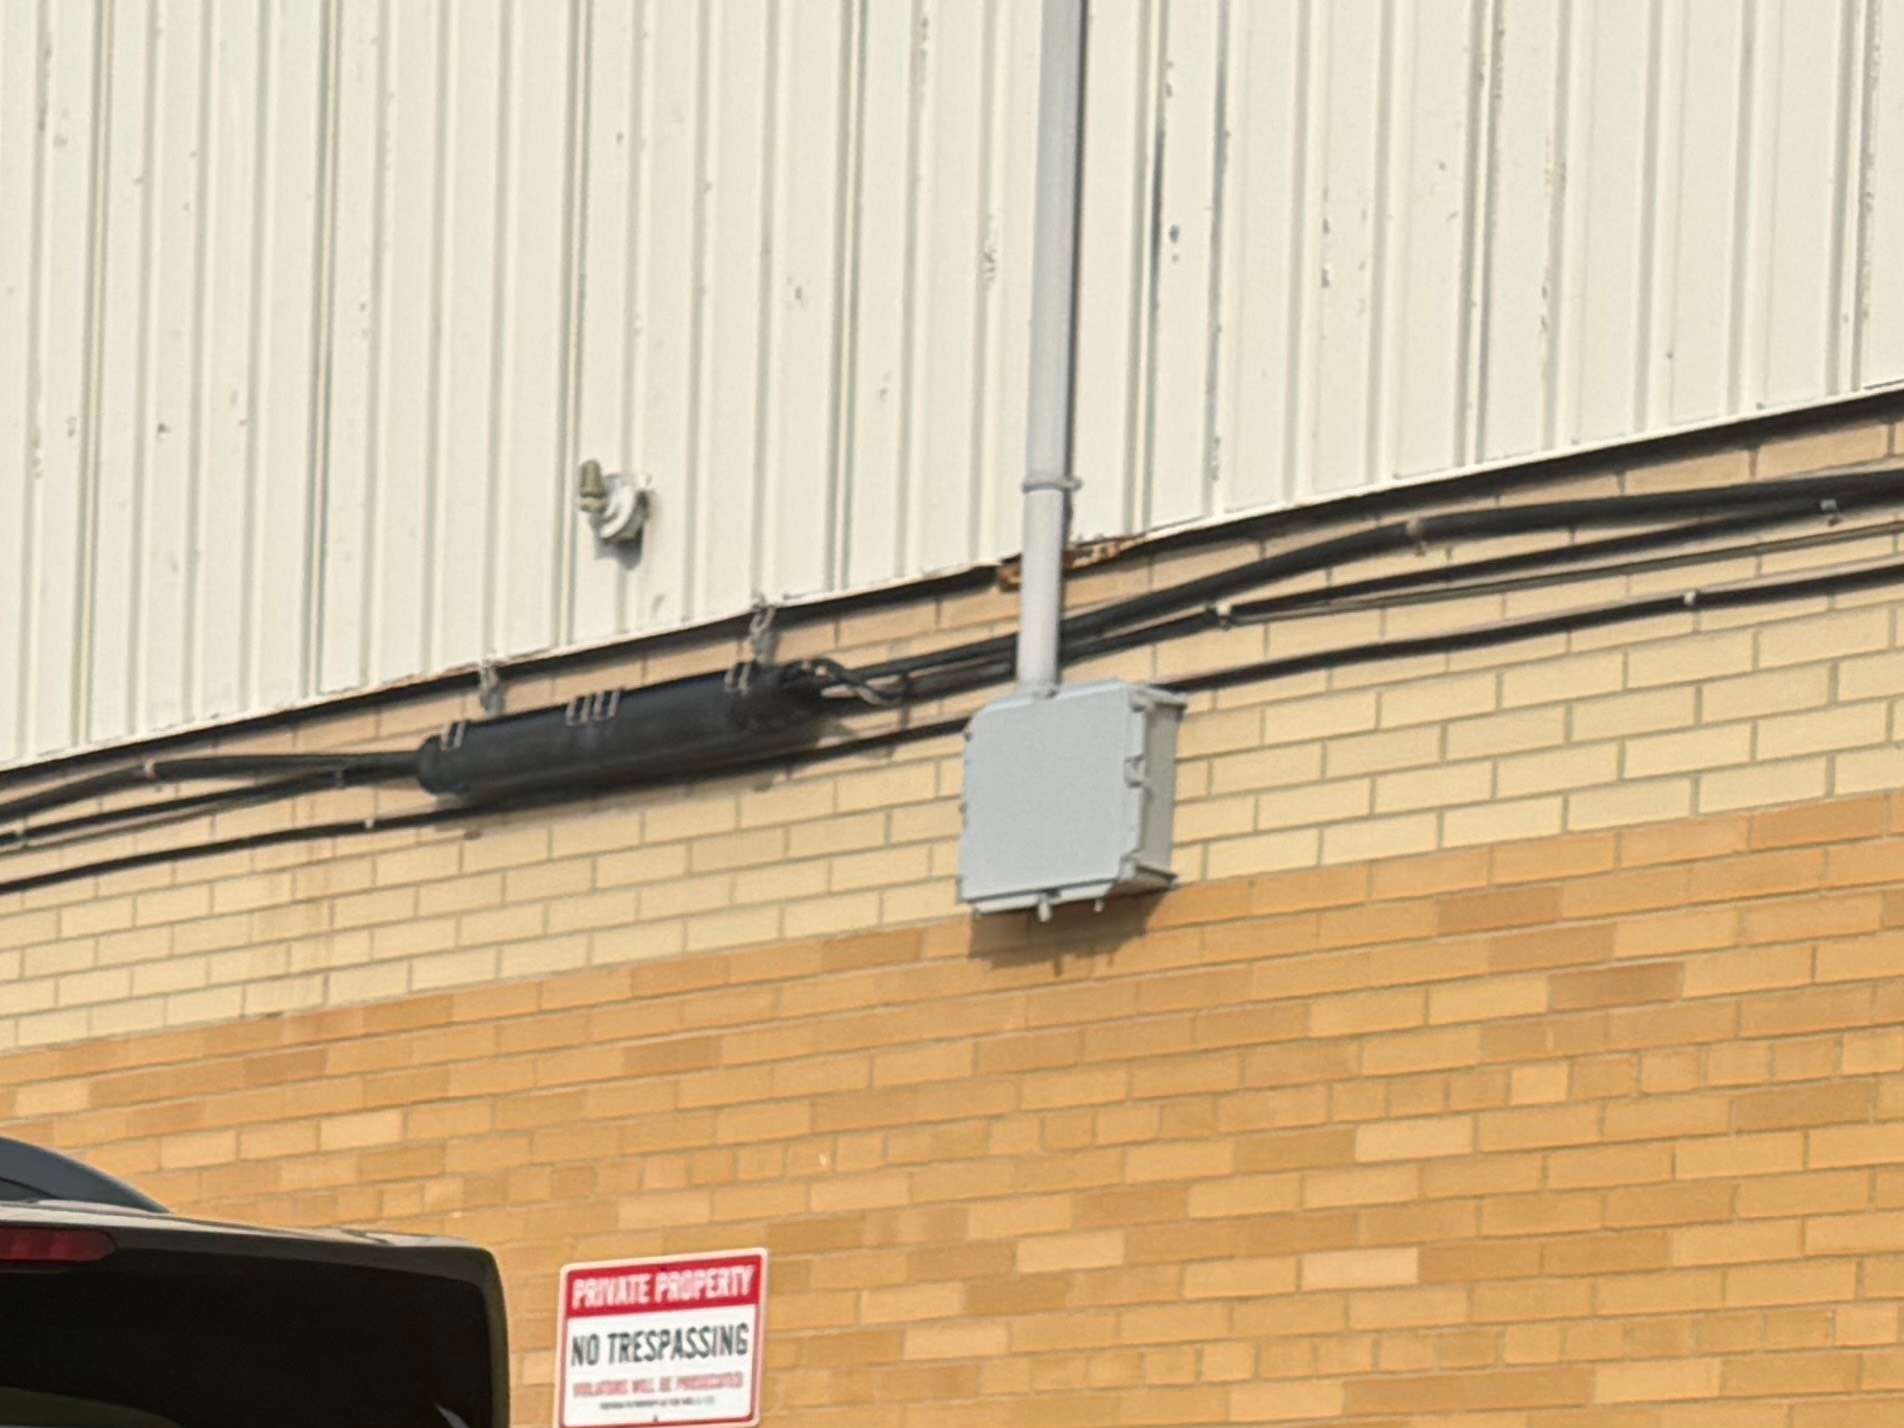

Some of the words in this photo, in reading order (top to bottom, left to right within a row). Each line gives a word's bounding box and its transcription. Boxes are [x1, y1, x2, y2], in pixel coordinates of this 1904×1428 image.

[572, 1273, 651, 1309] PRIVATE
[655, 1265, 755, 1303] PROPERTY
[571, 1333, 600, 1367] NO
[607, 1322, 749, 1365] TRESPASSING
